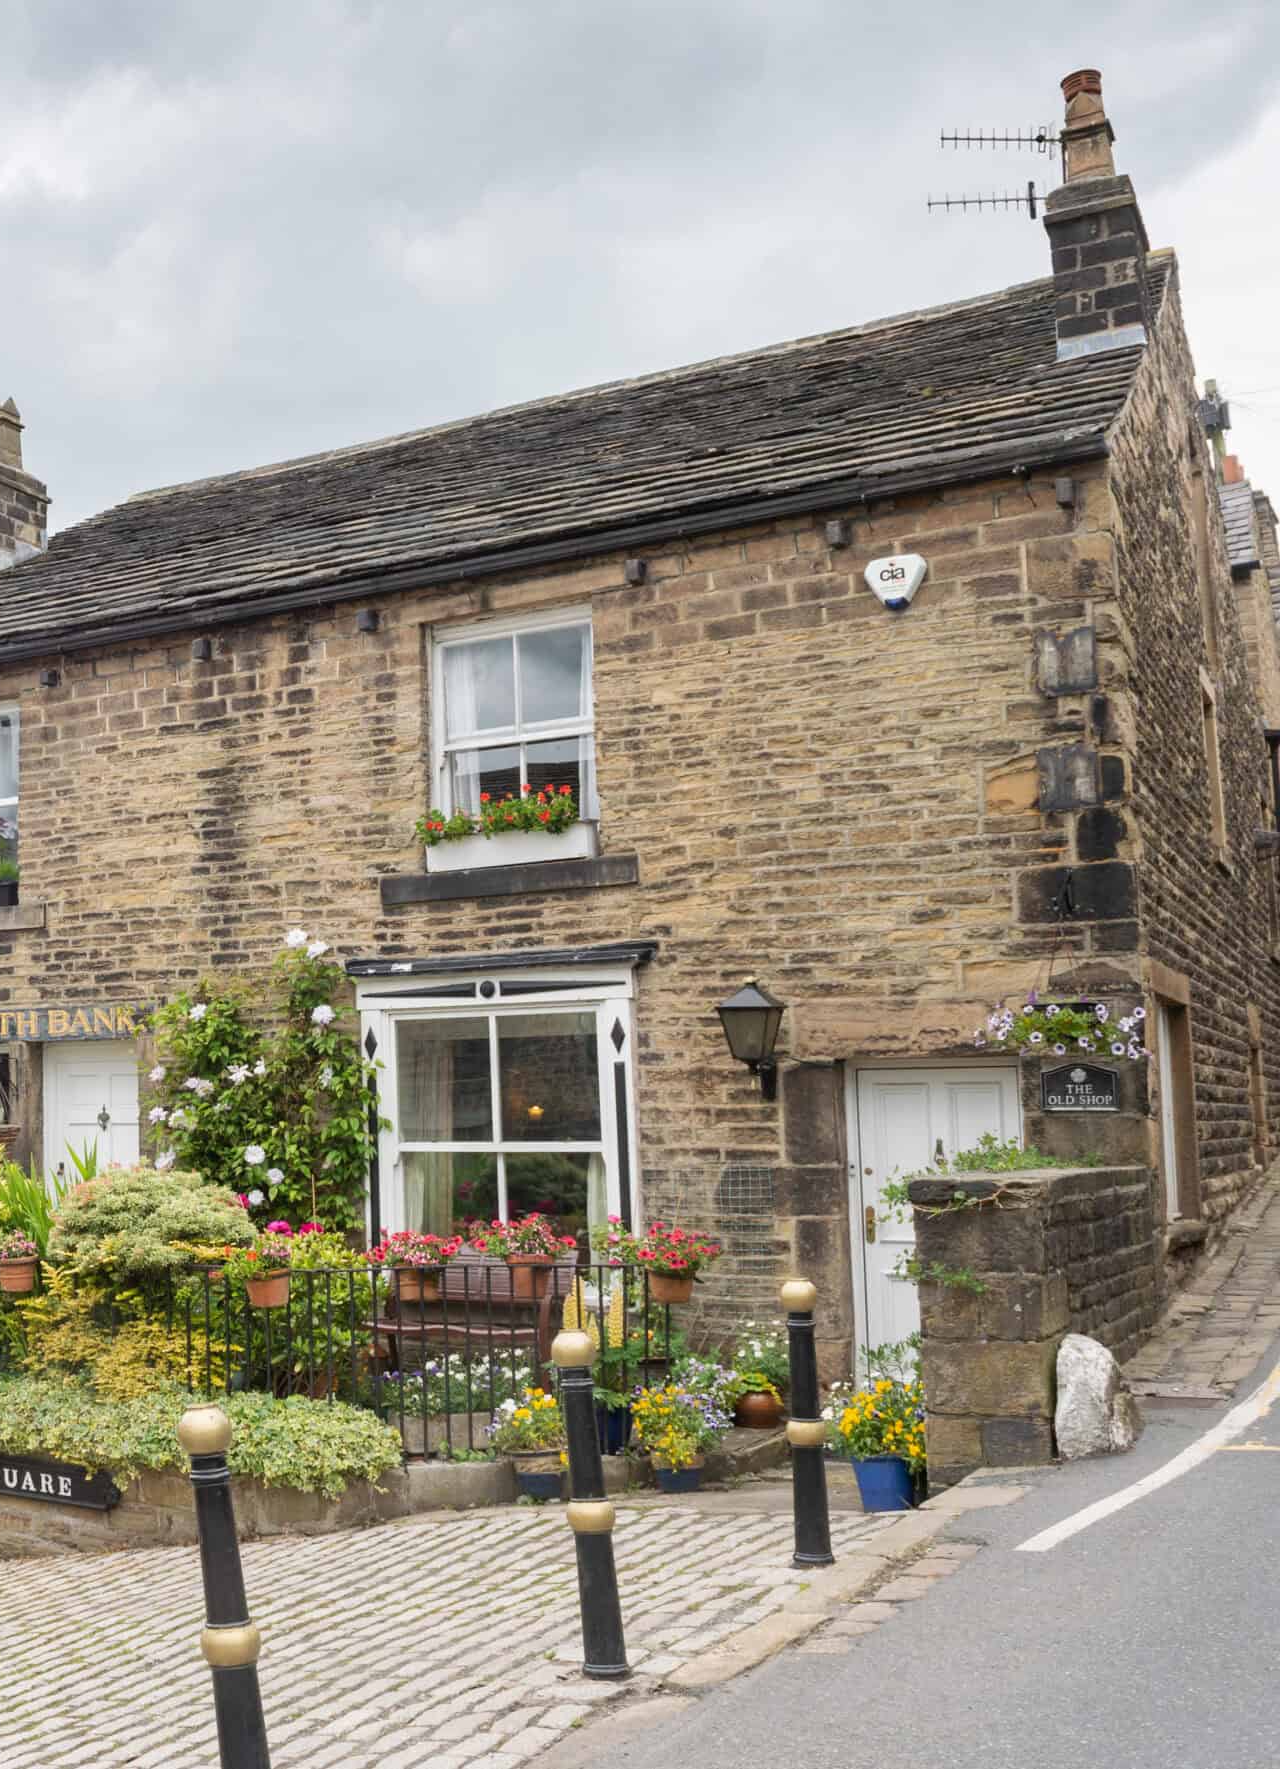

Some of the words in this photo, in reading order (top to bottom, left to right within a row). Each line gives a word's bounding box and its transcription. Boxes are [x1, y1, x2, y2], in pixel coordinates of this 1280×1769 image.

[1065, 1084, 1093, 1094] THE
[1048, 1095, 1075, 1105] OLD
[1079, 1095, 1113, 1105] SHOP
